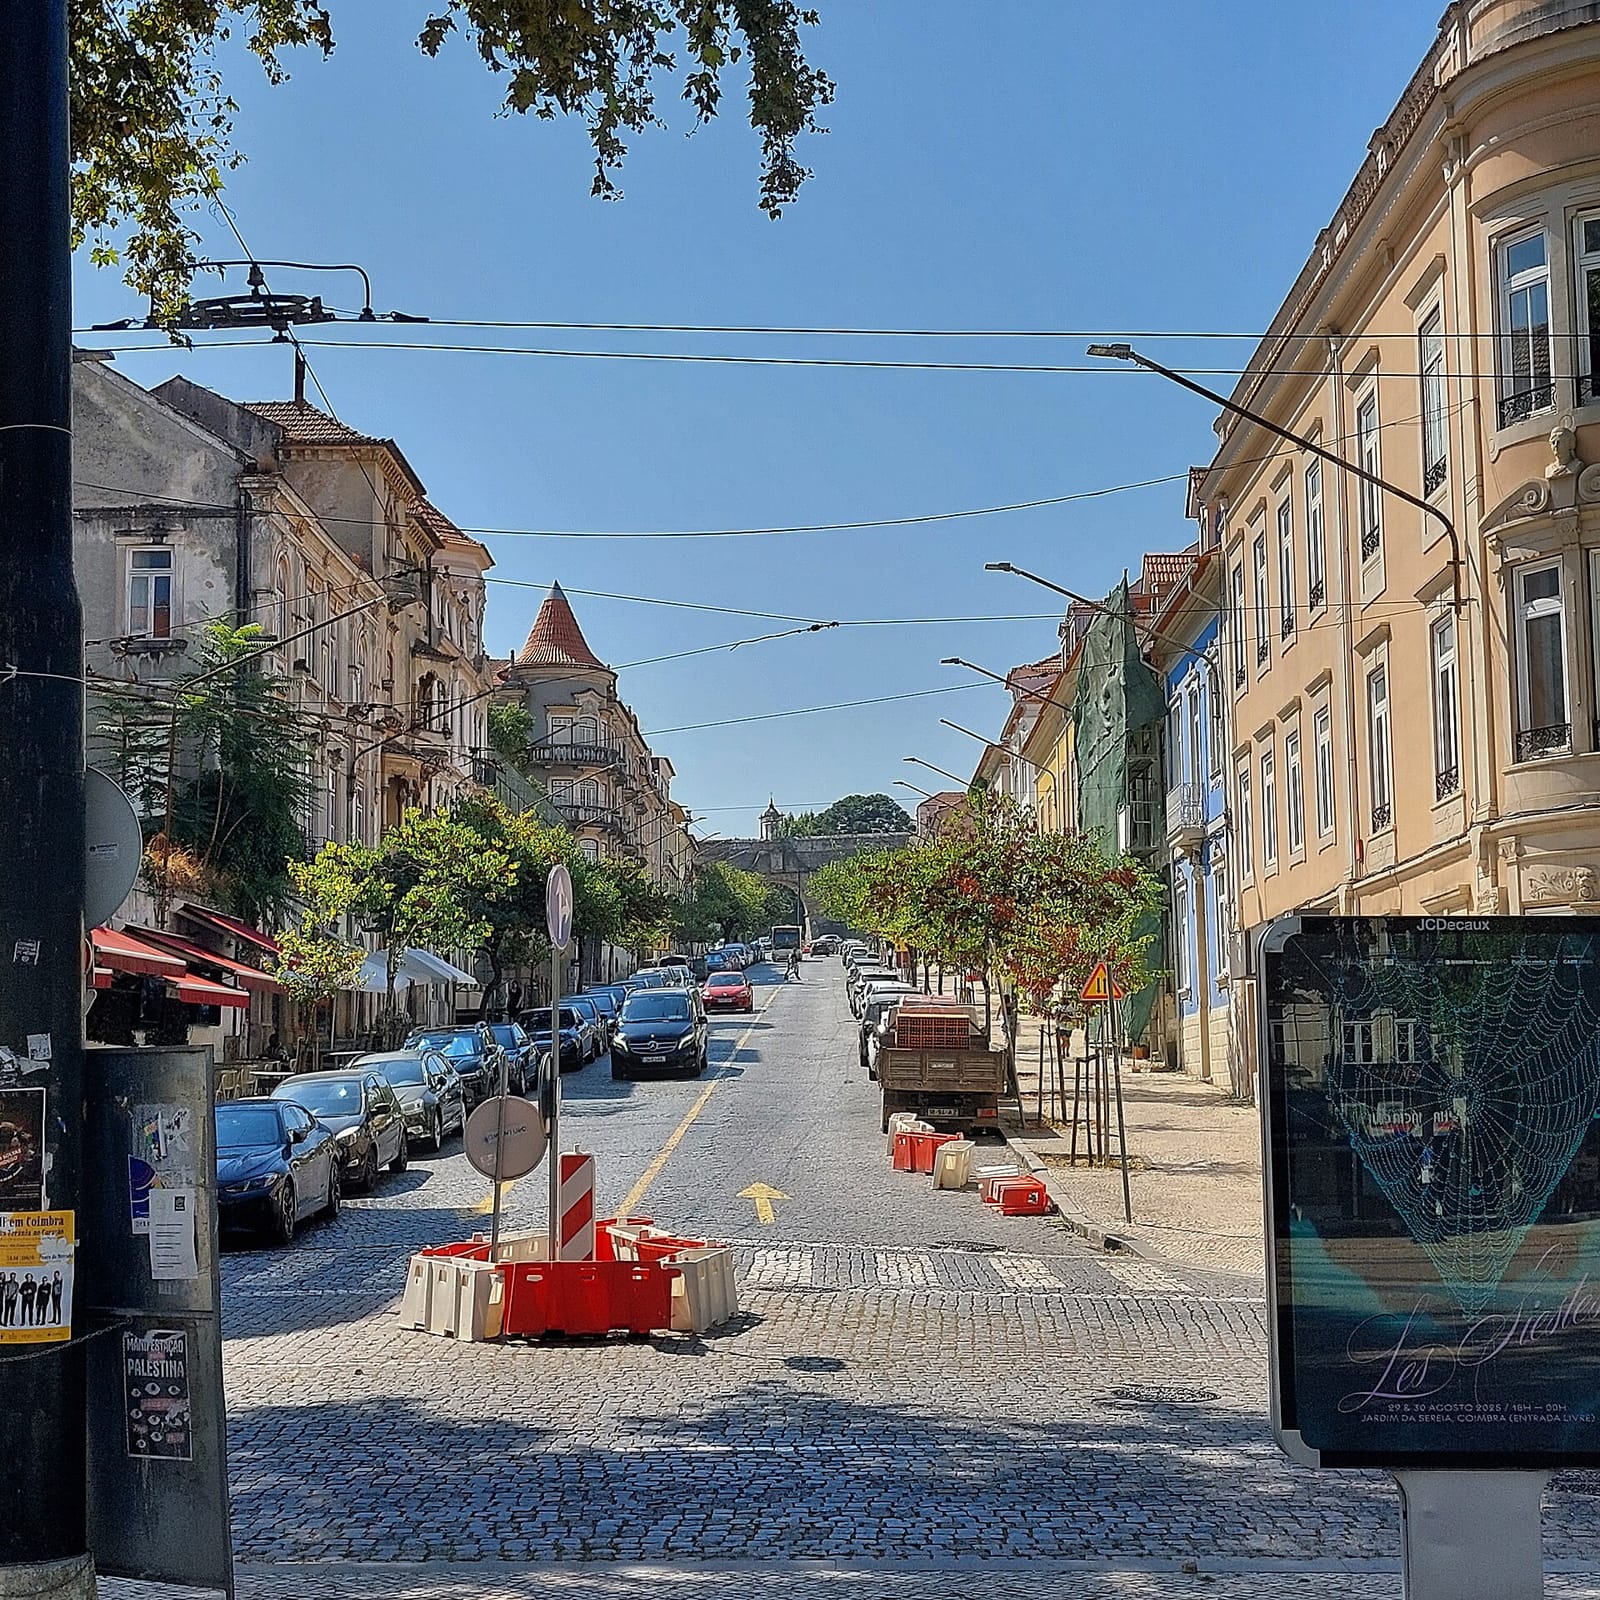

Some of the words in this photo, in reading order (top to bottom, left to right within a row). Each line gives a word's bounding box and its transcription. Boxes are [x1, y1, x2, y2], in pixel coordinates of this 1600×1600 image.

[1416, 918, 1490, 931] JCDecaux
[10, 1218, 24, 1227] em
[26, 1215, 65, 1227] Coimbra
[1338, 1293, 1456, 1413] Les
[127, 1358, 185, 1378] PALESTINA
[1387, 1403, 1401, 1412] 29
[1403, 1403, 1411, 1412] &
[1413, 1403, 1426, 1412] 30
[1428, 1403, 1473, 1412] AGOSTO
[1475, 1403, 1502, 1412] 2025
[1361, 1414, 1399, 1422] JARDIM
[1401, 1414, 1417, 1422] DA
[1456, 1414, 1506, 1422] COIMBRA
[1509, 1414, 1561, 1423] (ENTRADA
[1563, 1414, 1596, 1422] LIVRE)
